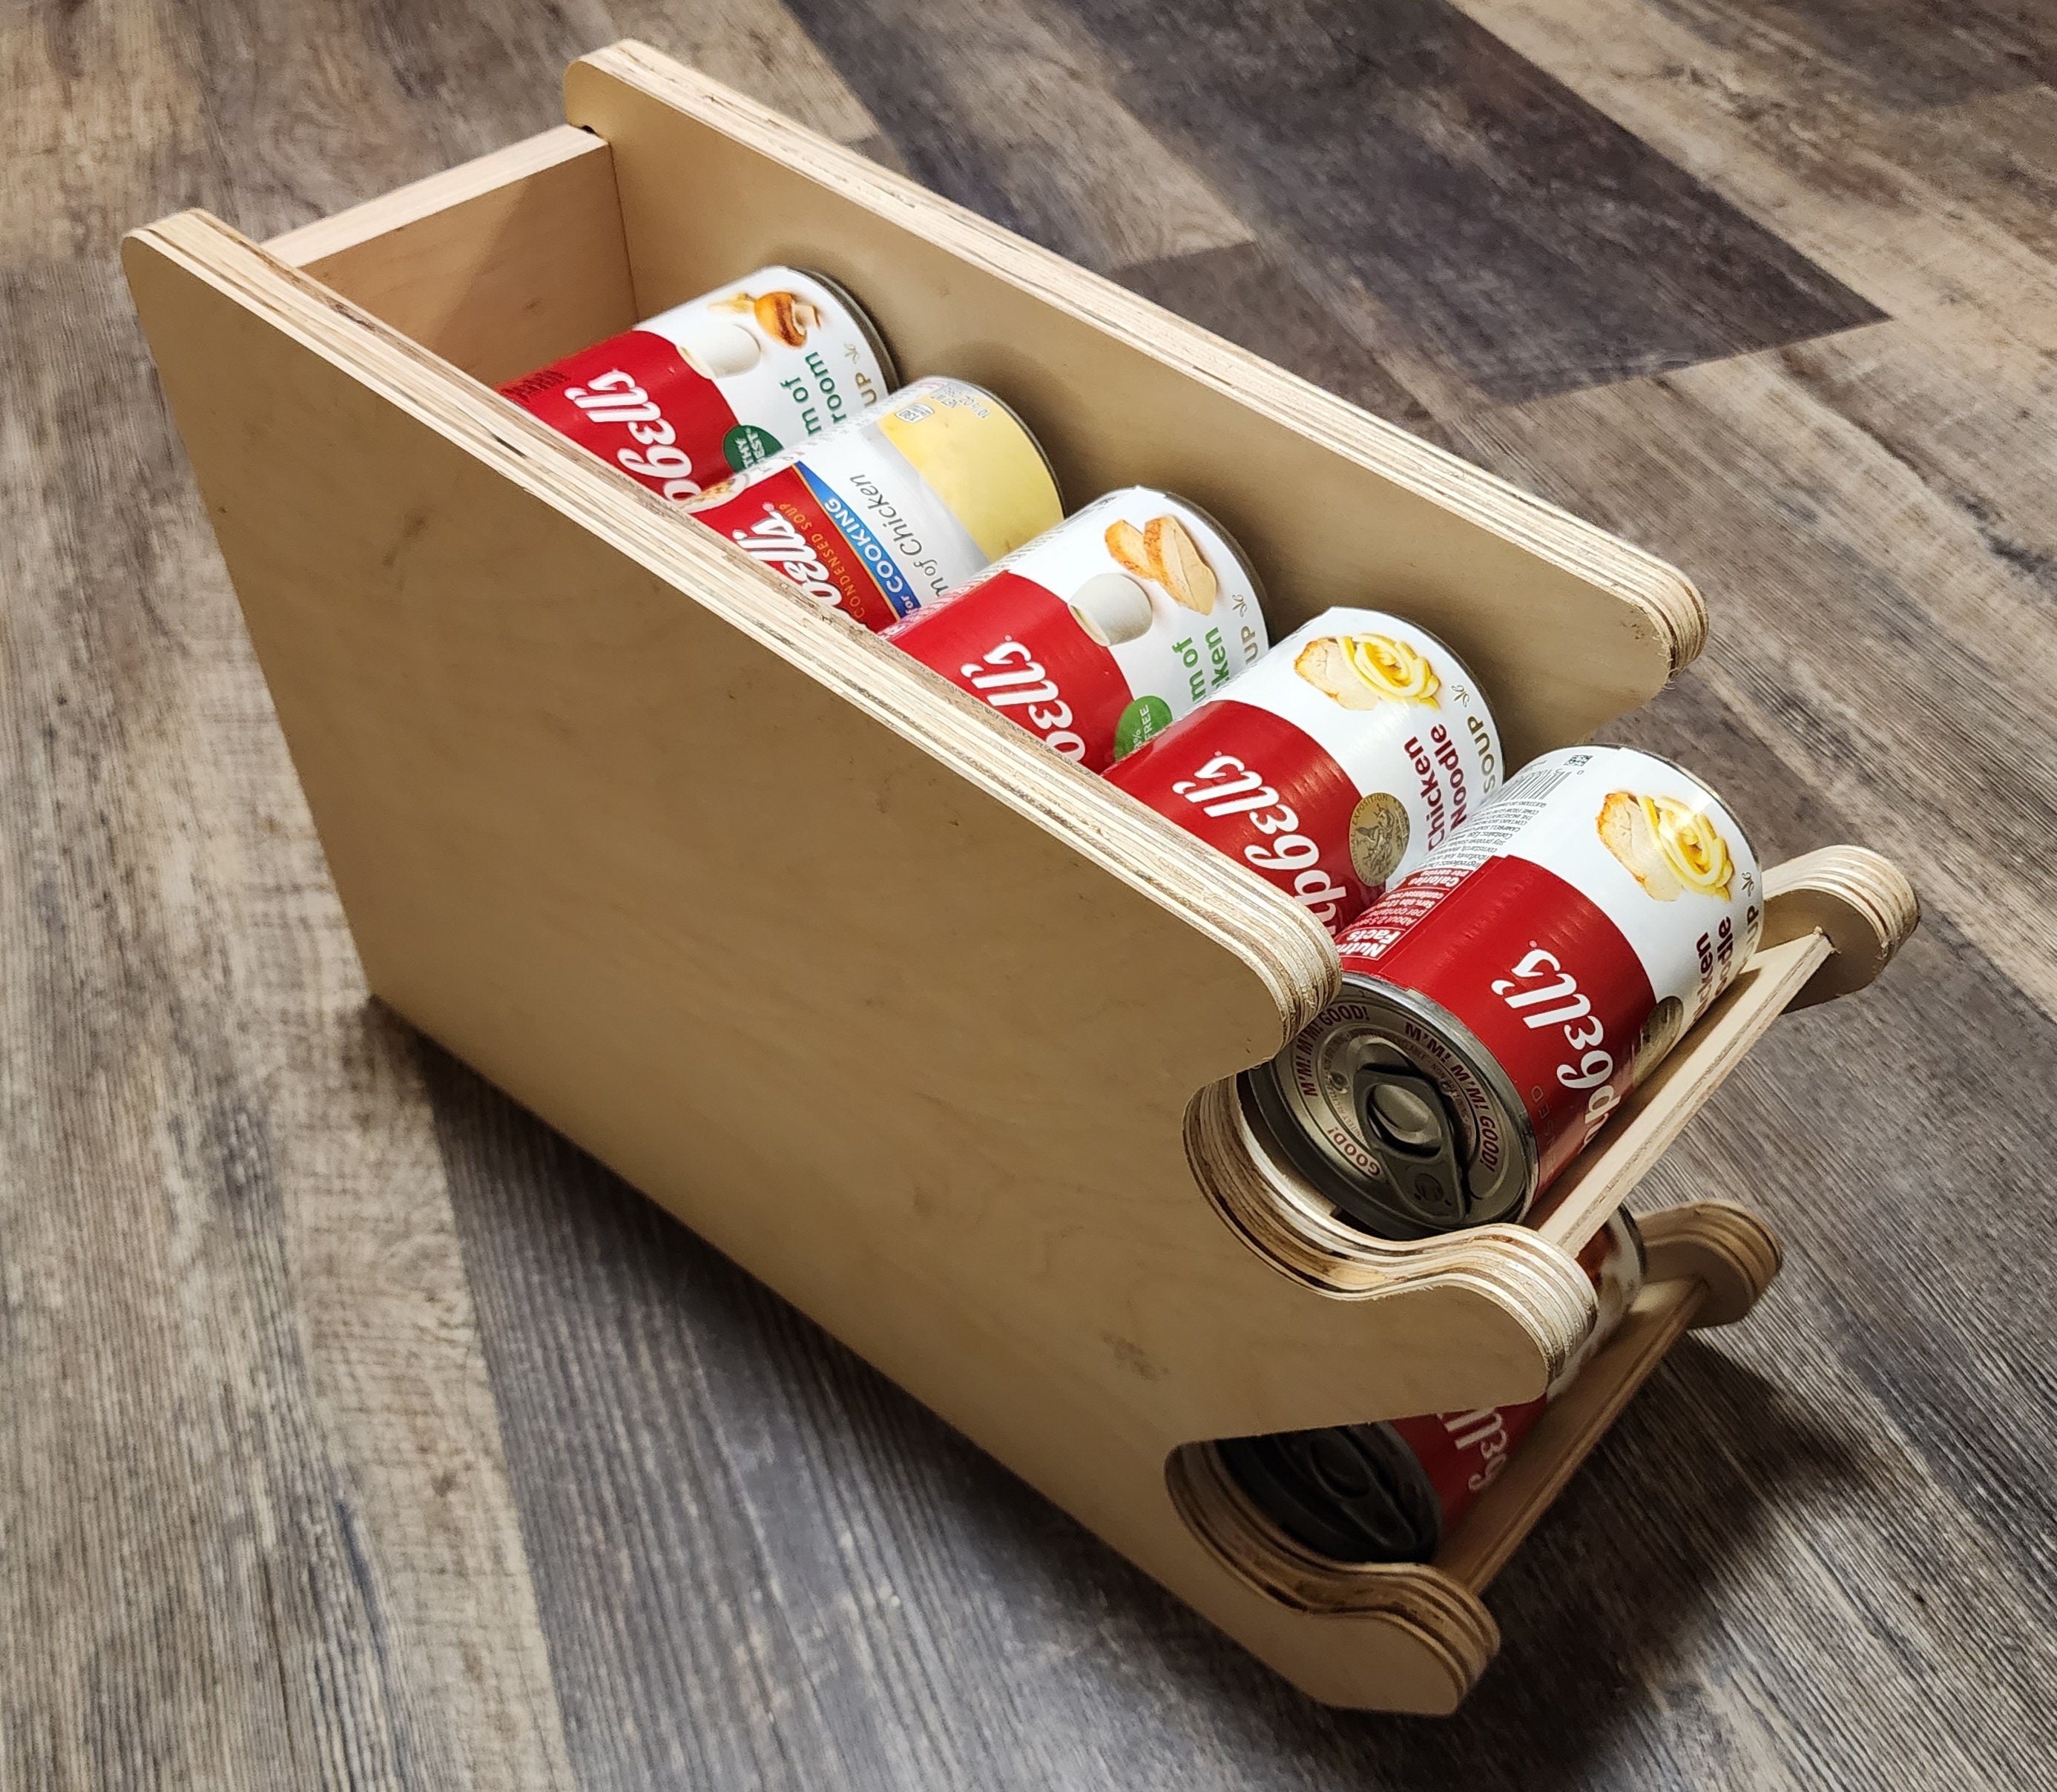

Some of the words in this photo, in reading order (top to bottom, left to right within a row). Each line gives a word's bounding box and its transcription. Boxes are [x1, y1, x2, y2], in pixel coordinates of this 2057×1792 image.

[780, 377, 809, 403] of
[779, 502, 812, 530] SOUP
[849, 474, 923, 556] Chicken
[824, 498, 904, 593] COOKING
[811, 533, 866, 619] CONDENSED
[913, 559, 938, 576] of
[1171, 636, 1199, 668] of
[1139, 704, 1153, 741] FREE
[1467, 716, 1496, 794] SOUP
[1430, 723, 1467, 832] Noodle
[1407, 875, 1461, 888] Calories
[1346, 929, 1401, 945] Facts
[1405, 1021, 1452, 1064] M'M!
[1451, 1064, 1490, 1110] M'M!
[1479, 1115, 1499, 1172] GOOD!
[1327, 1126, 1380, 1176] GOOD!
